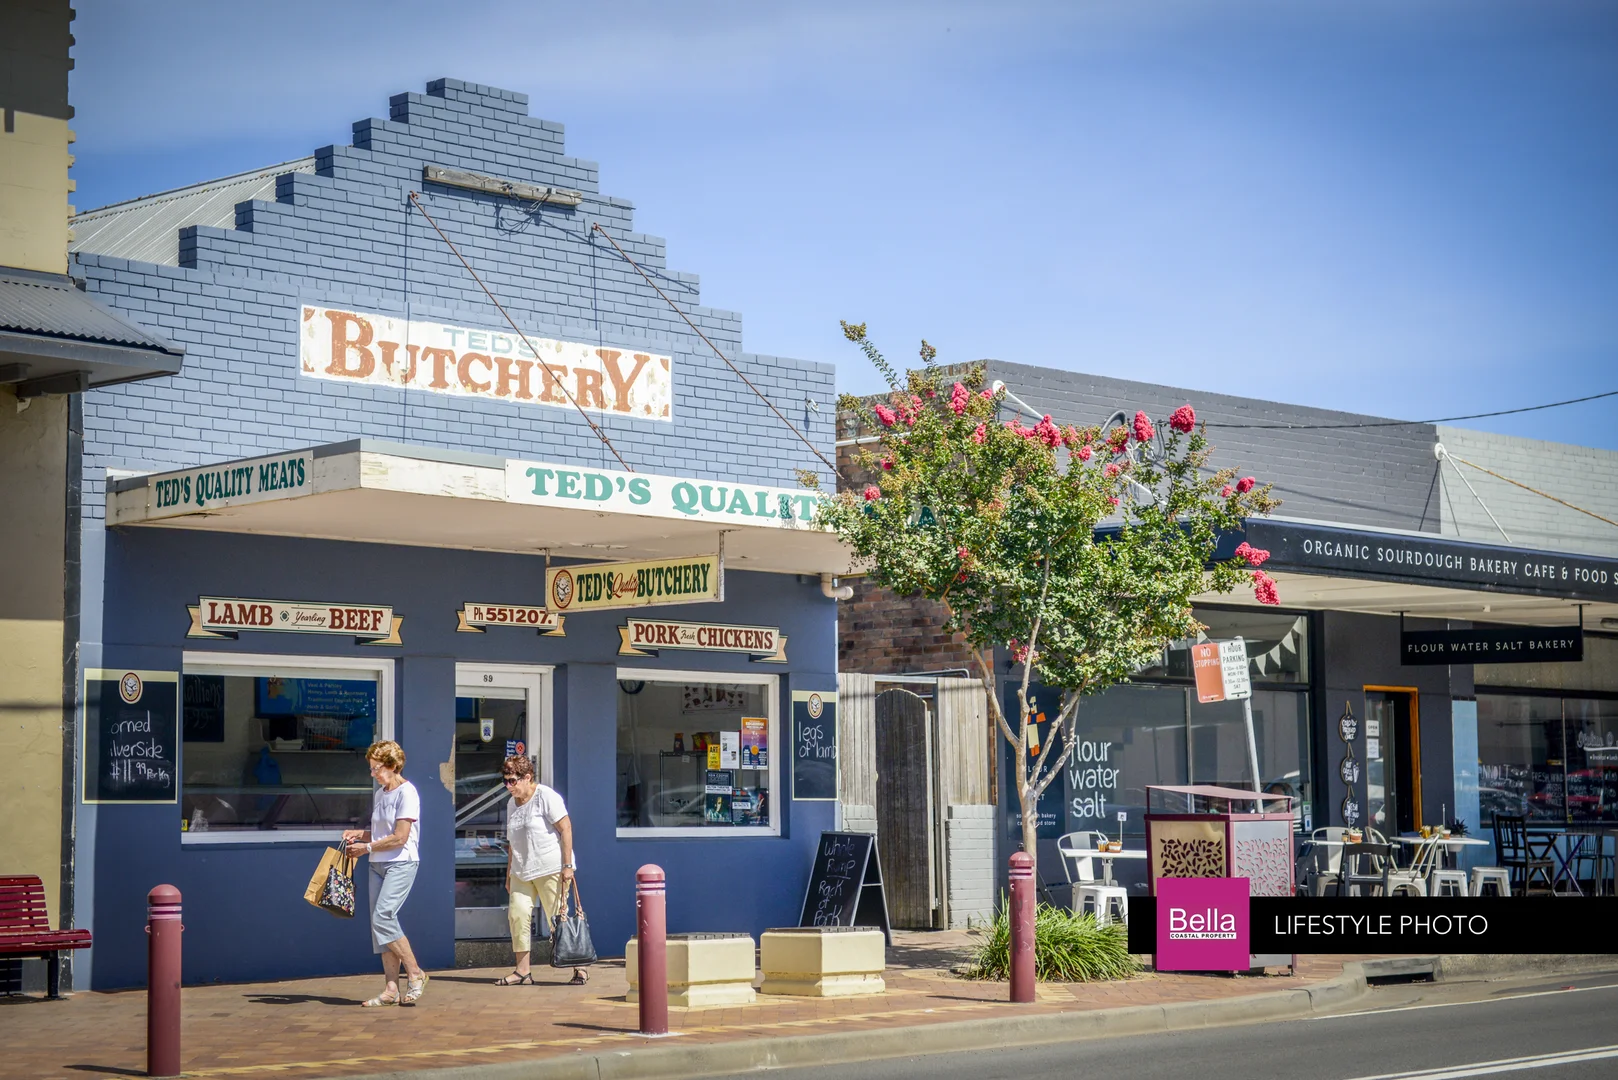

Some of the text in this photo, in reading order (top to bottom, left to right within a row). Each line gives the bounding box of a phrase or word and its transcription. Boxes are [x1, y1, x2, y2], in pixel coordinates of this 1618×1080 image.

[324, 310, 649, 412] BUTCHERY
[156, 458, 305, 508] TED'S QUALITY MEATS
[525, 467, 651, 505] TED'S
[1303, 539, 1369, 561] ORGANIC
[1377, 548, 1463, 570] SOURDOUGH
[1471, 557, 1517, 576] BAKERY
[1524, 563, 1556, 579] CAFE
[1561, 567, 1568, 580] &
[1575, 568, 1608, 584] FOOD
[577, 563, 711, 602] TED'S Quality BUTCHERY
[207, 602, 384, 631] LAMB Yearling BEEF
[473, 606, 484, 620] Ph
[633, 622, 774, 650] PORK Fresh CHICKENS
[1223, 644, 1242, 654] 1 HOUR
[1408, 639, 1575, 653] FLOUR WATER SALT BAKERY
[1195, 658, 1220, 668] STOPPING
[1200, 647, 1211, 658] NO
[1222, 654, 1245, 664] PARKING
[483, 674, 493, 682] 89
[799, 736, 837, 759] of lamb
[1070, 735, 1112, 767] flour
[1069, 764, 1120, 790] water
[1072, 791, 1106, 818] salt
